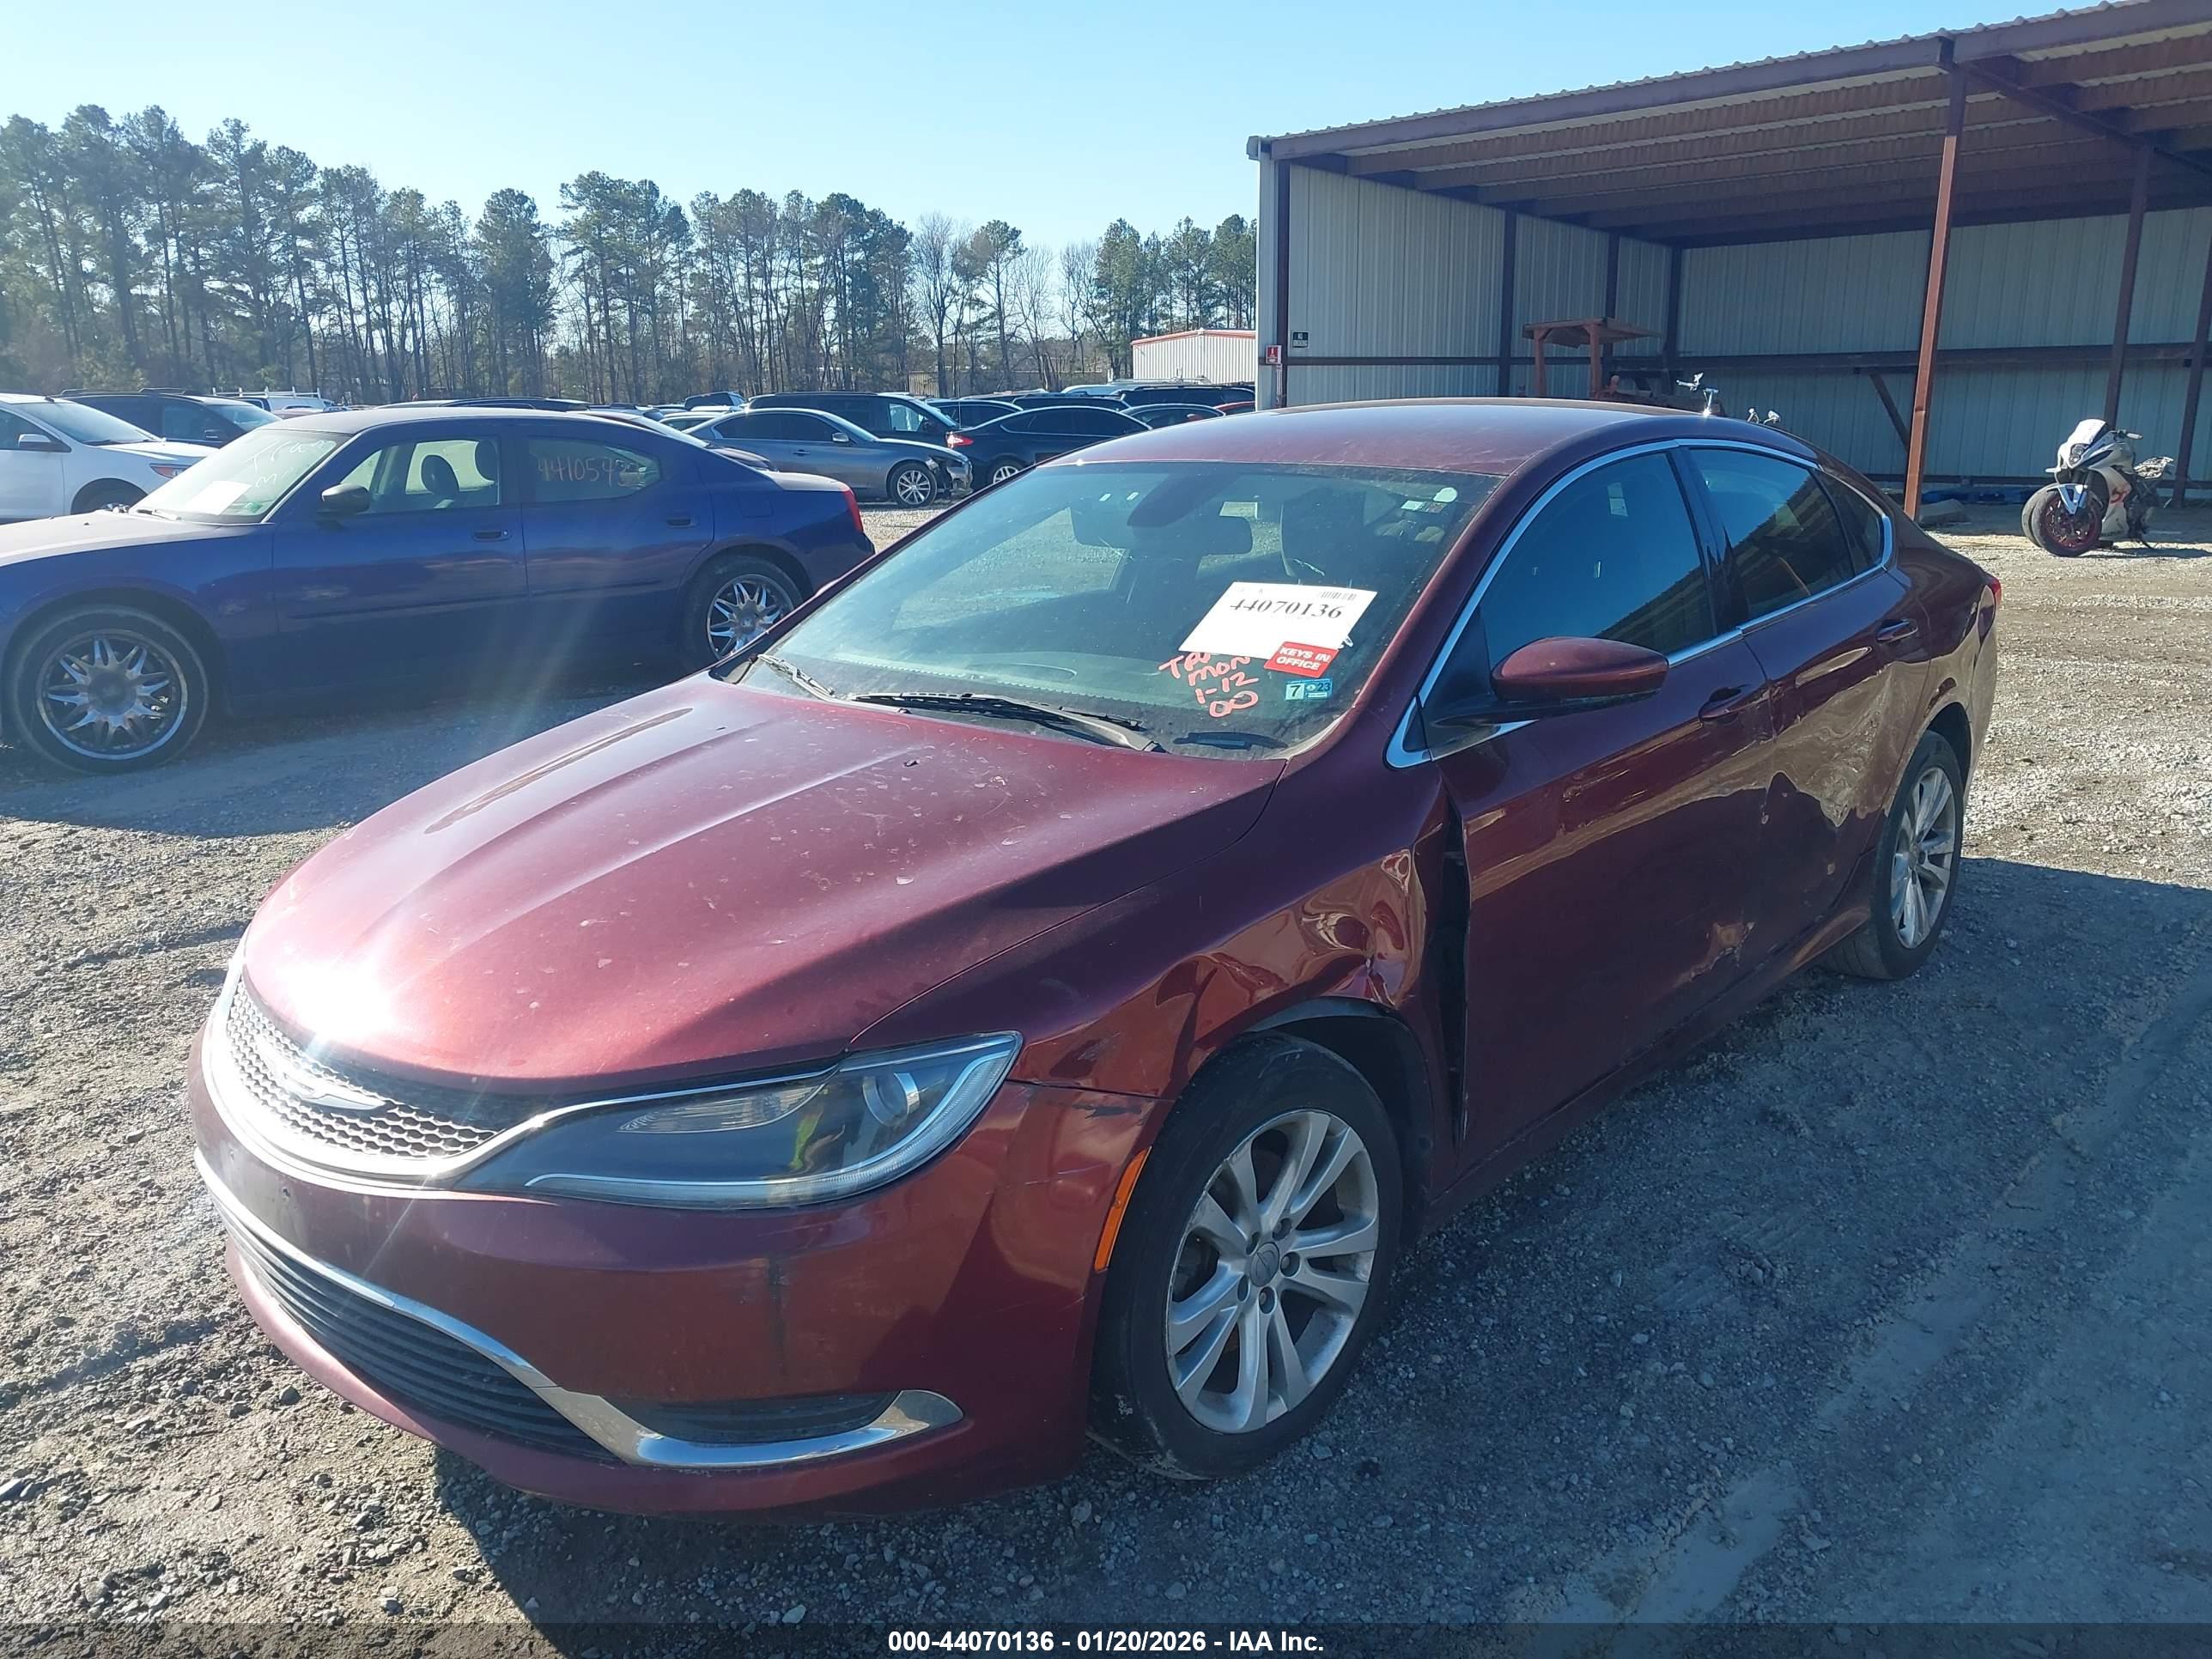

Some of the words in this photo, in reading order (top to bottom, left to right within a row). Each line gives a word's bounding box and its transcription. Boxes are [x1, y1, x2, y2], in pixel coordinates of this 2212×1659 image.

[1229, 599, 1346, 619] 44070136
[1279, 646, 1314, 659] KEYS
[1314, 653, 1331, 663] IN
[1276, 656, 1322, 671] OFFICE
[1290, 684, 1302, 697] 7
[1316, 682, 1331, 692] 23
